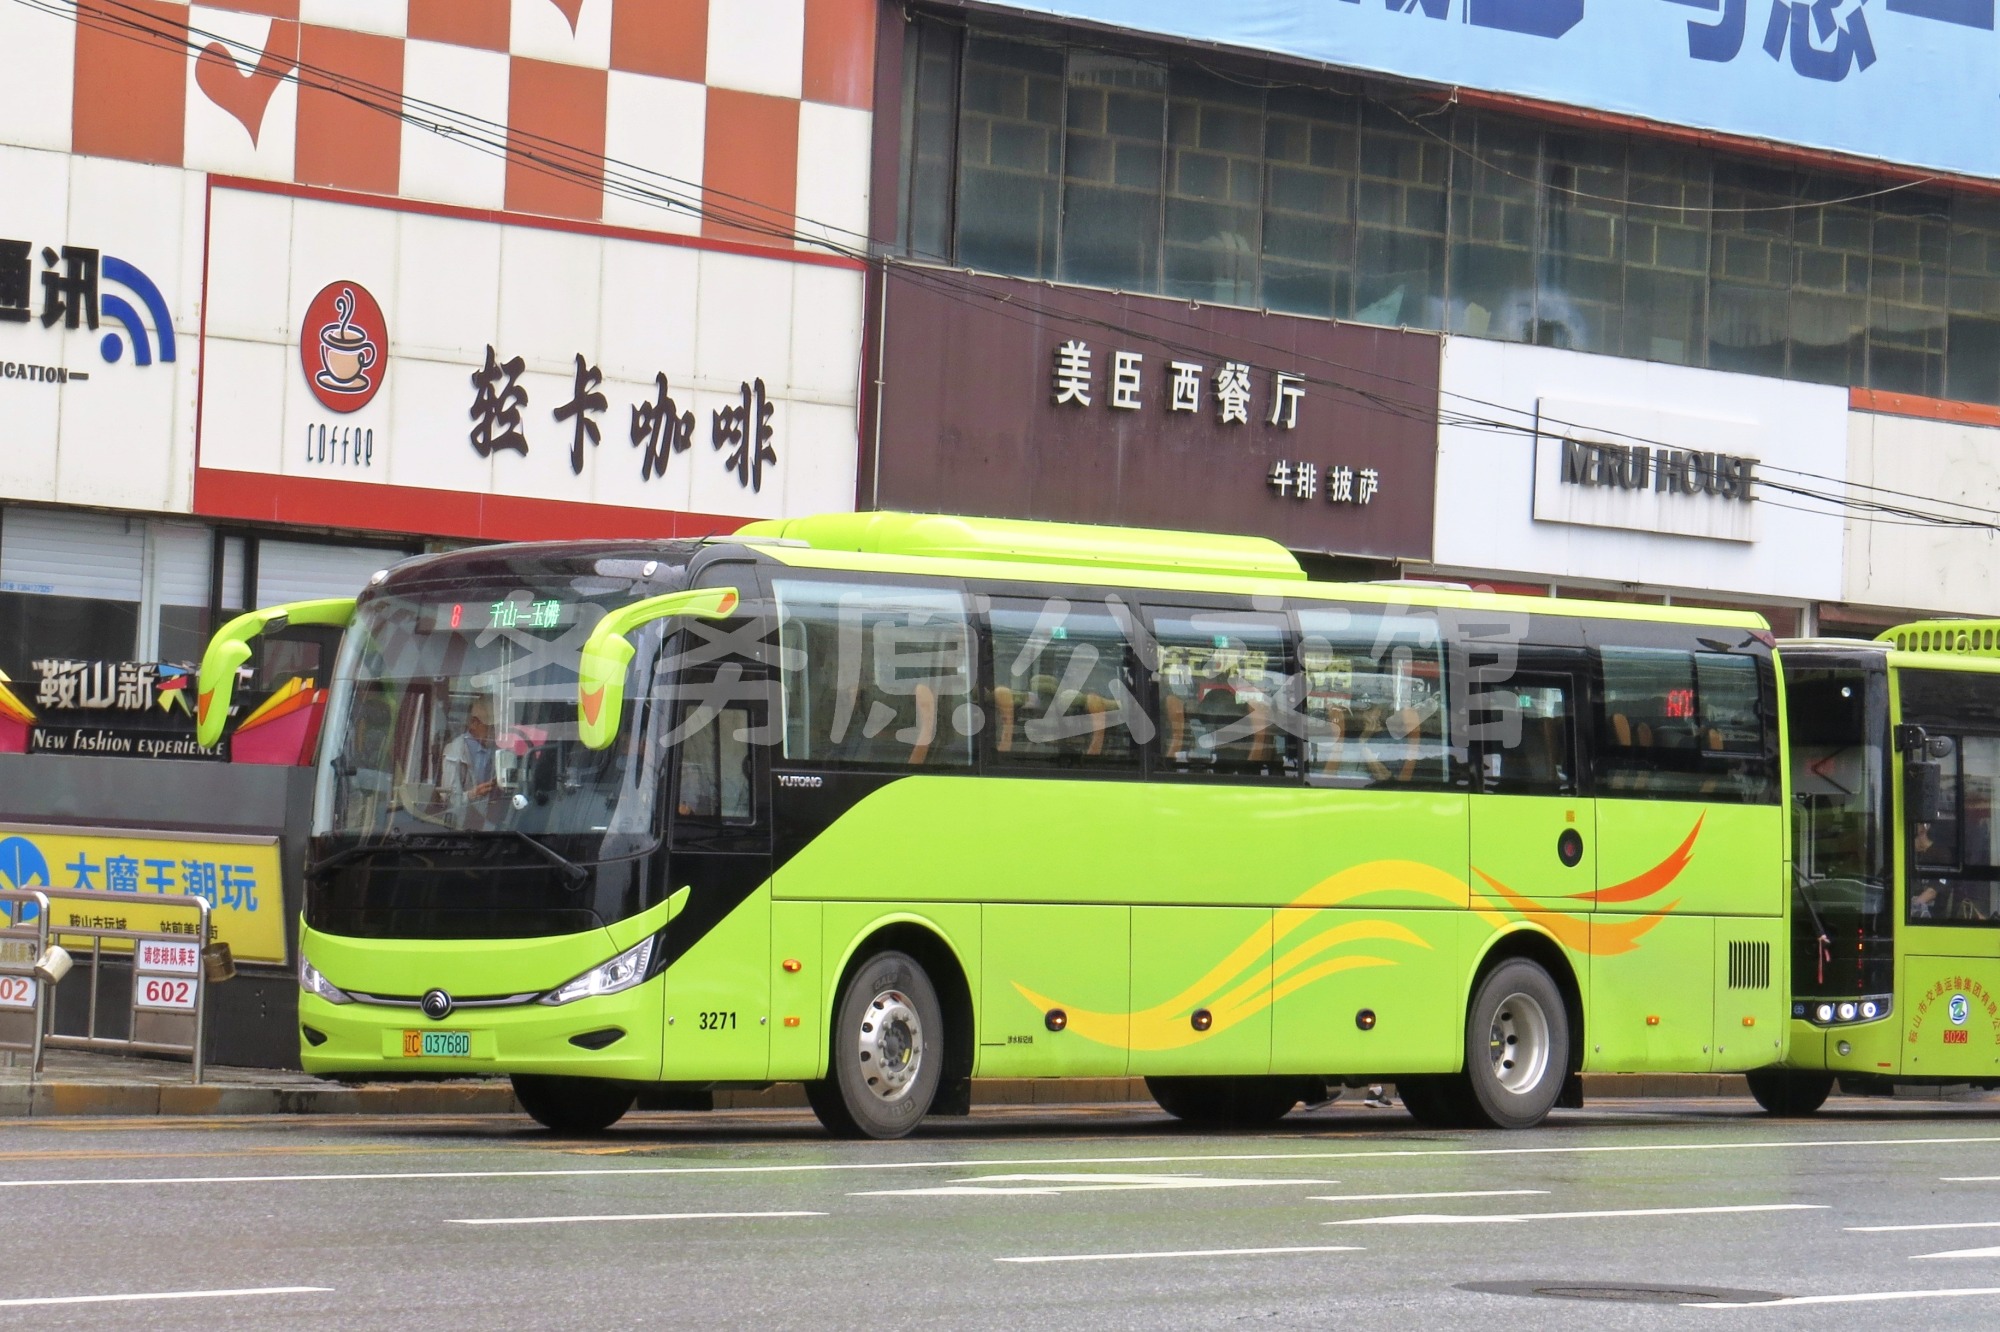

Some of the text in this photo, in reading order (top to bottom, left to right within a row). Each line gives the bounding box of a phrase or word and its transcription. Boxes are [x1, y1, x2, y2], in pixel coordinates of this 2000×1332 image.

[1054, 340, 1306, 430] 美臣西餐厅
[470, 343, 777, 494] 轻卡咖啡
[1655, 449, 1761, 502] HOUSE
[777, 774, 823, 788] YUTONG
[144, 946, 195, 967] 请您排队乘车
[146, 980, 189, 1003] 602
[699, 1011, 736, 1030] 3271
[1944, 1031, 1967, 1043] 3023
